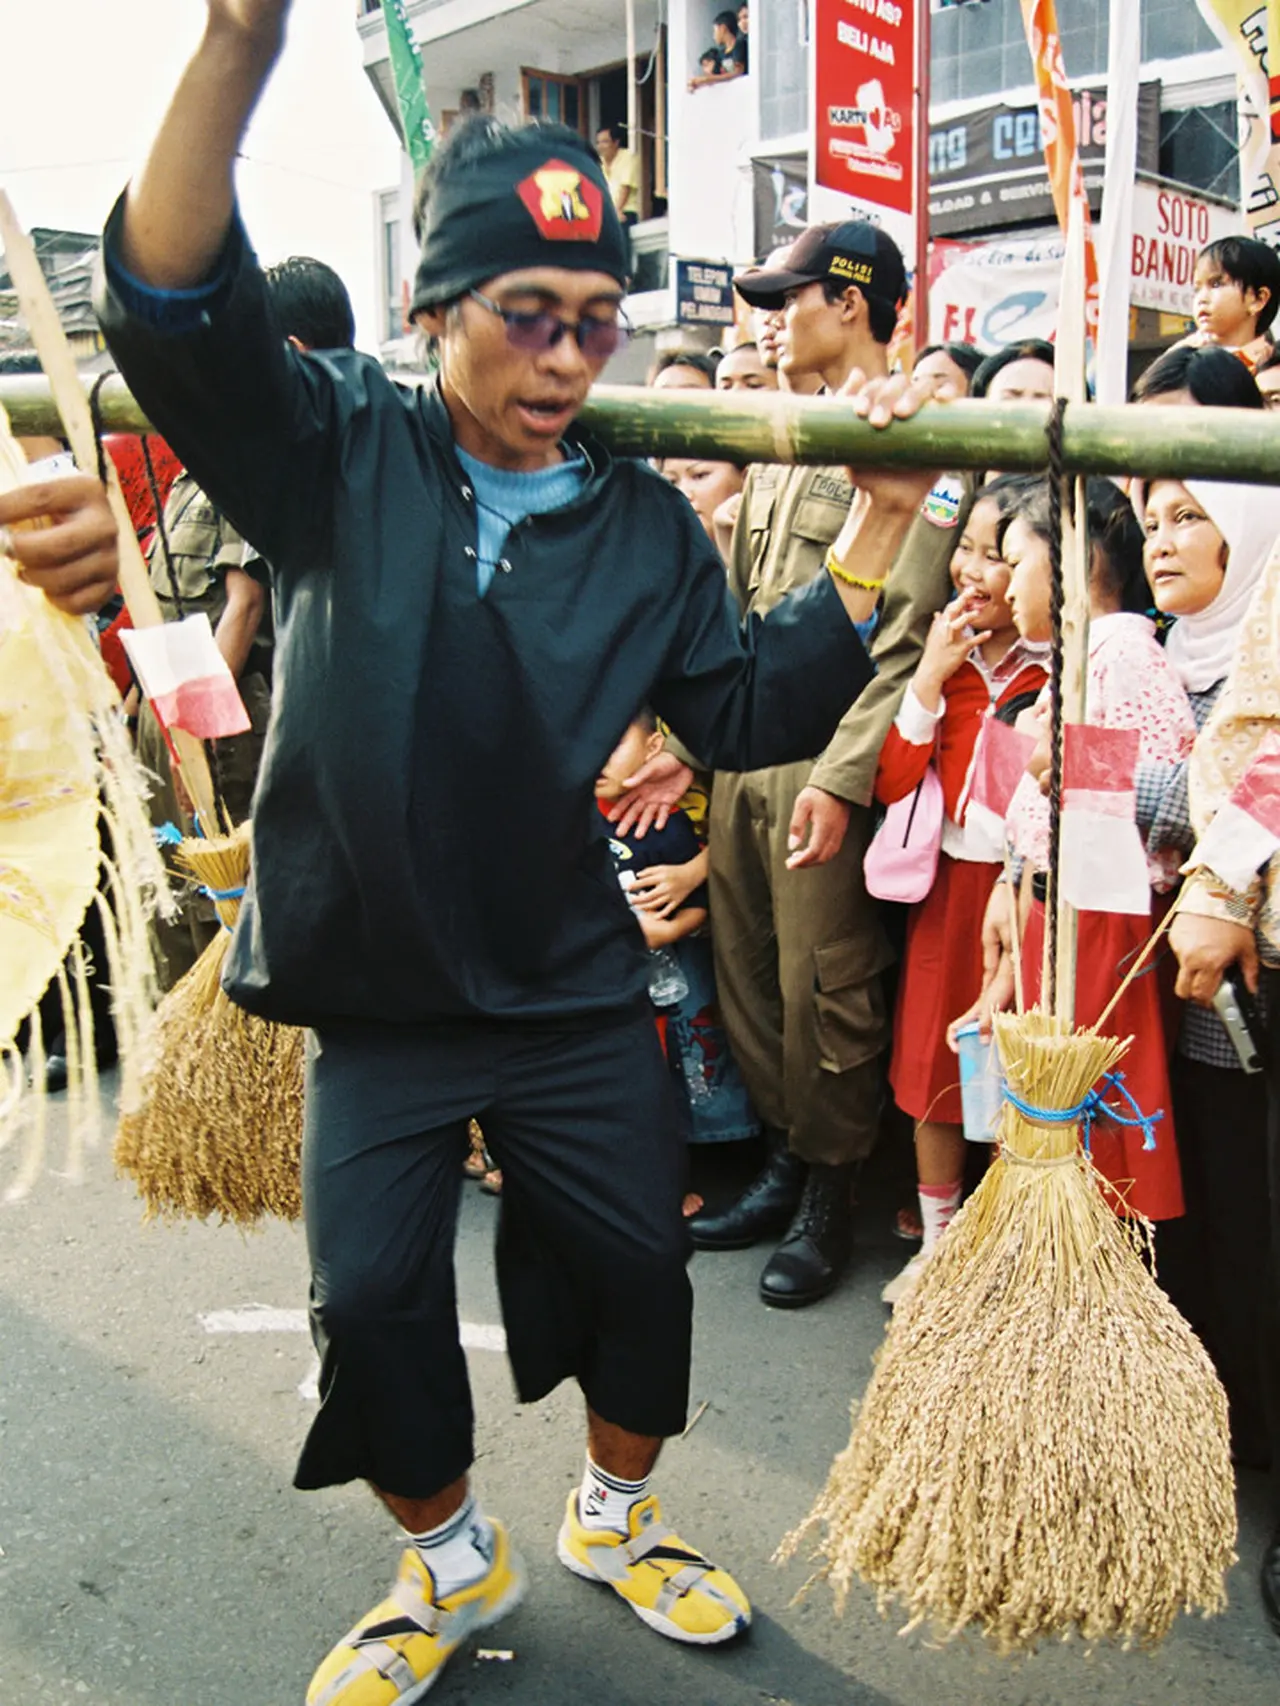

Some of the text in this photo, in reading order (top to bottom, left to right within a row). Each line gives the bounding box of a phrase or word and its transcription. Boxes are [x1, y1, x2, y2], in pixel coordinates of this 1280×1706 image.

[837, 20, 895, 66] BELI AJA
[1157, 191, 1209, 245] SOTO
[831, 255, 873, 277] POLISI
